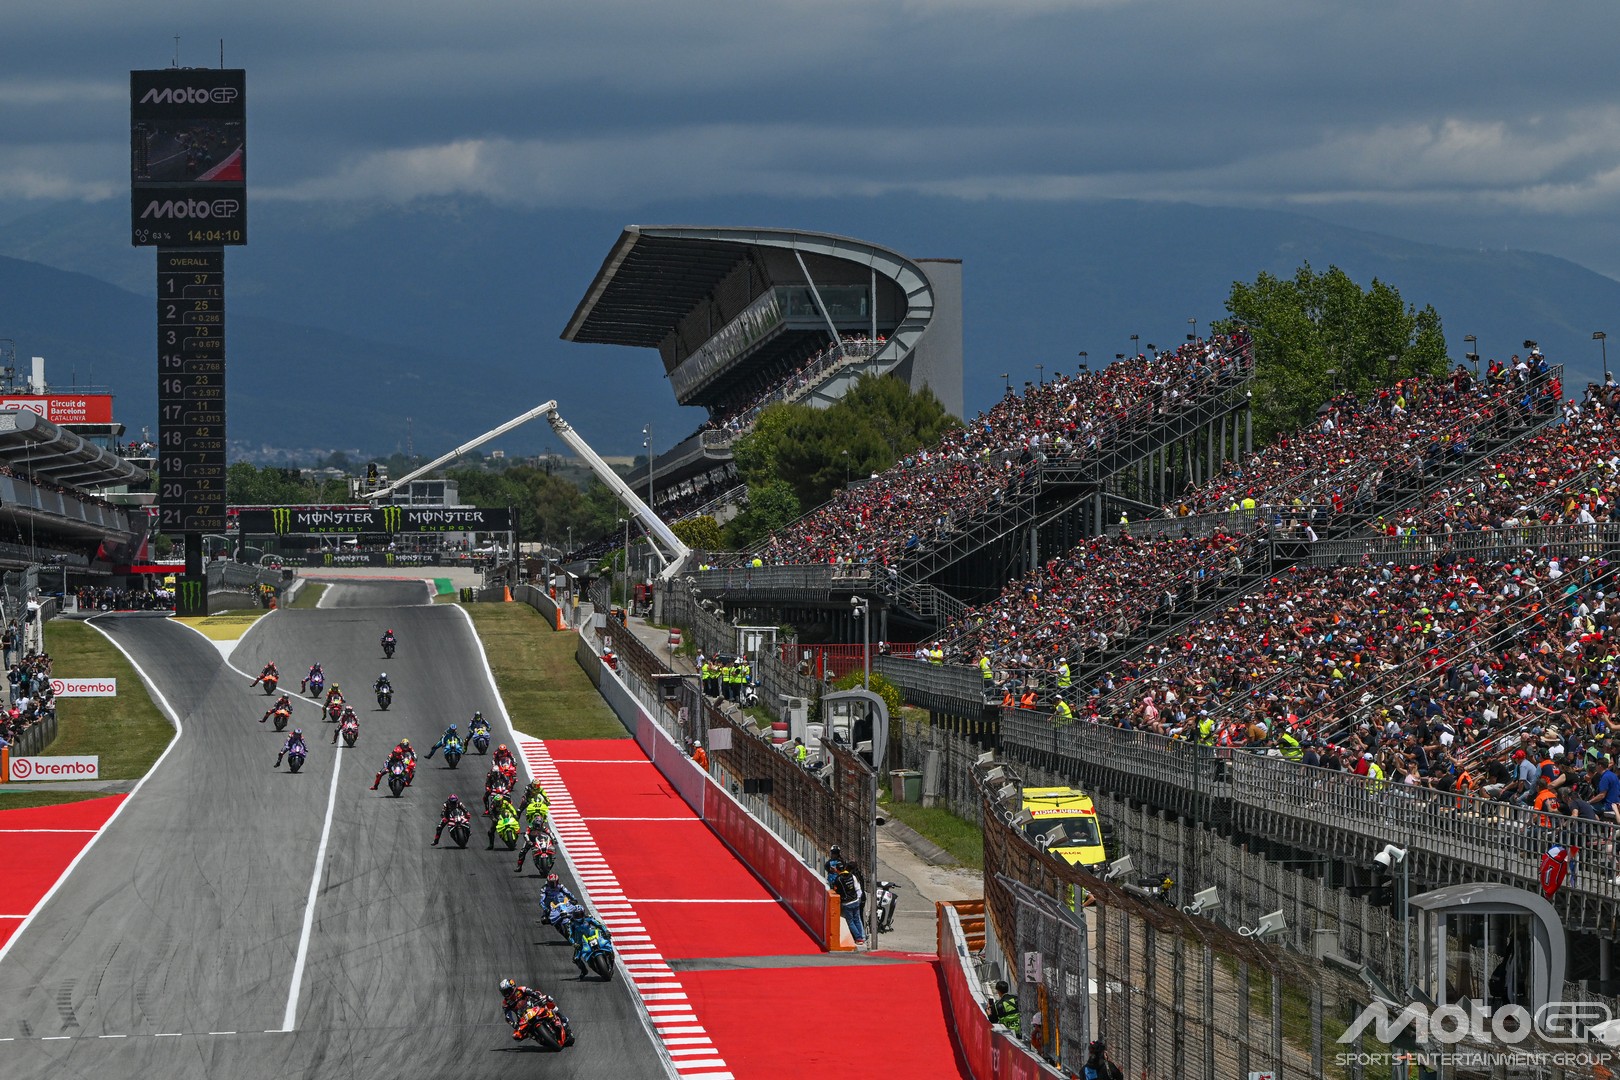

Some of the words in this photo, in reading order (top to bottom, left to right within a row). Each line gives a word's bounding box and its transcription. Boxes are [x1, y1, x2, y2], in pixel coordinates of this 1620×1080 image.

[139, 87, 239, 104] MotoGP
[140, 198, 240, 219] MotoGP
[187, 230, 240, 241] 14:04:10
[170, 258, 209, 266] OVERALL
[167, 278, 174, 293] 1
[194, 274, 207, 285] 37
[166, 304, 176, 319] 2
[194, 300, 209, 311] 25
[166, 330, 176, 345] 3
[194, 326, 209, 337] 73
[162, 354, 182, 368] 15
[162, 378, 182, 394] 16
[195, 375, 209, 385] 23
[50, 400, 75, 408] Circuit
[76, 400, 86, 408] de
[196, 401, 208, 411] 11
[50, 407, 86, 415] Barcelona
[162, 405, 182, 420] 17
[163, 431, 182, 446] 18
[196, 427, 209, 437] 42
[163, 457, 182, 472] 19
[199, 453, 206, 463] 7
[163, 483, 183, 498] 20
[196, 479, 210, 490] 12
[163, 509, 181, 524] 21
[196, 505, 210, 515] 47
[298, 511, 374, 525] MONSTER
[408, 510, 485, 524] MONSTER
[67, 683, 115, 692] brembo
[35, 761, 96, 774] brembo
